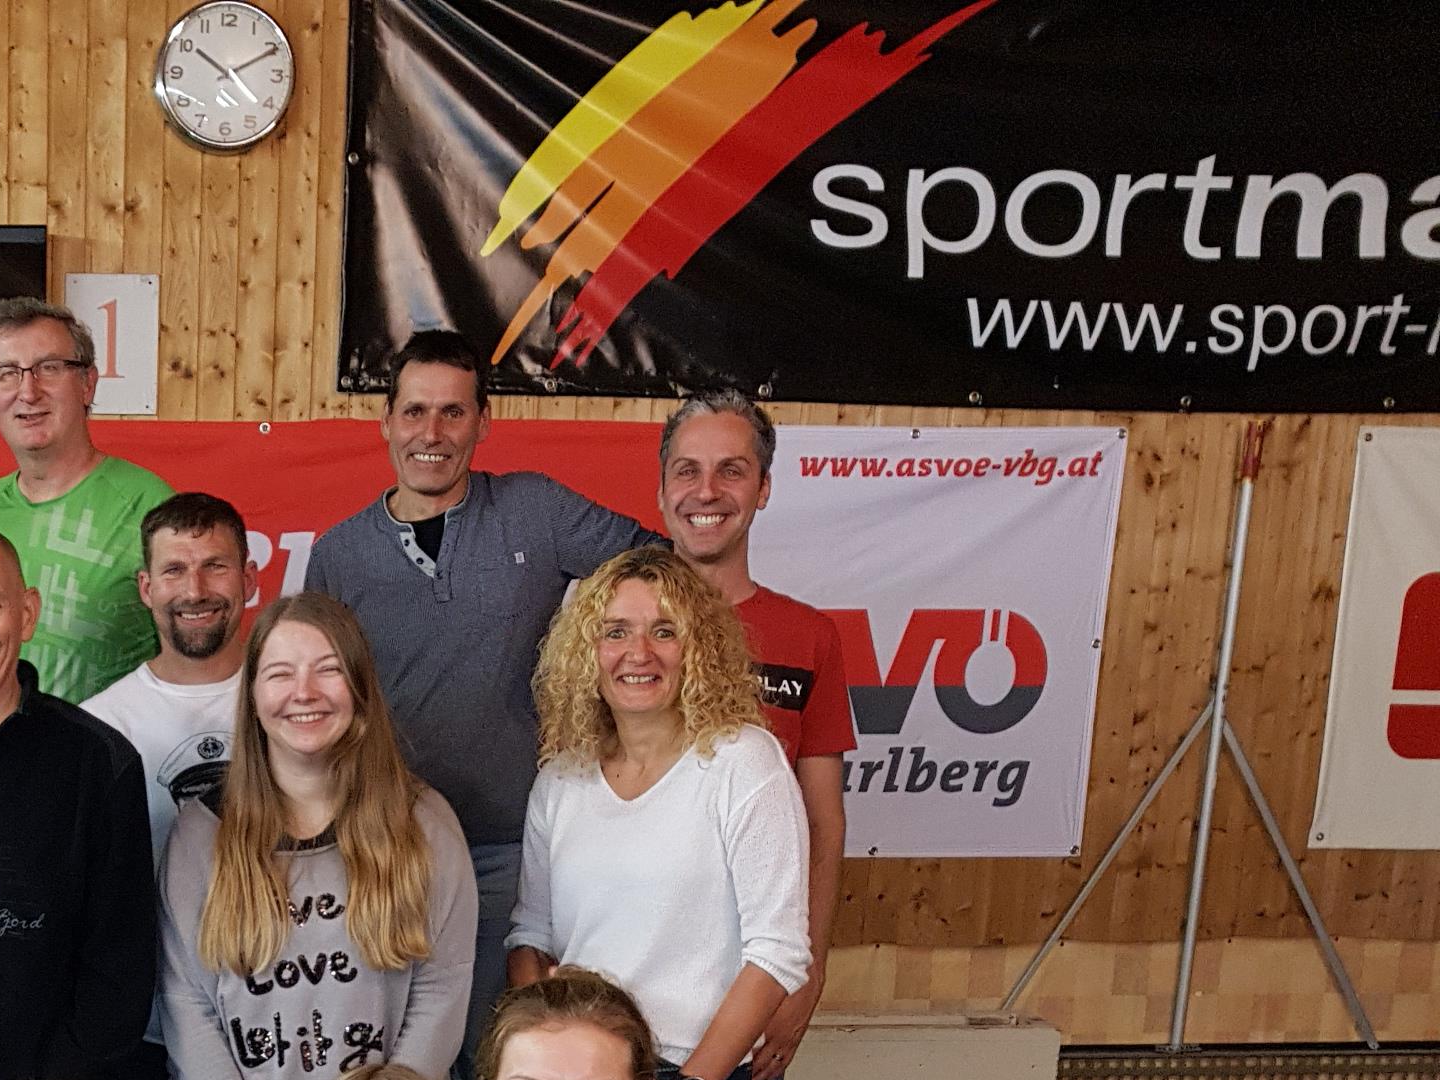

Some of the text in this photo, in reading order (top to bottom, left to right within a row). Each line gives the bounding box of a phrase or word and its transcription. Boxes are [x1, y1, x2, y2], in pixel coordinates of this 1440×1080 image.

[200, 19, 210, 34] 11
[221, 13, 238, 27] 12
[179, 39, 193, 53] 10
[170, 66, 183, 79] 9
[270, 69, 284, 83] 3
[176, 94, 190, 108] 8
[262, 95, 275, 110] 4
[195, 113, 207, 128] 7
[244, 115, 257, 129] 5
[219, 122, 231, 136] 6
[97, 299, 125, 378] 1
[967, 295, 1440, 371] www.sport-
[799, 449, 1103, 485] www.asvoe-vbg.at
[296, 1009, 333, 1072] it
